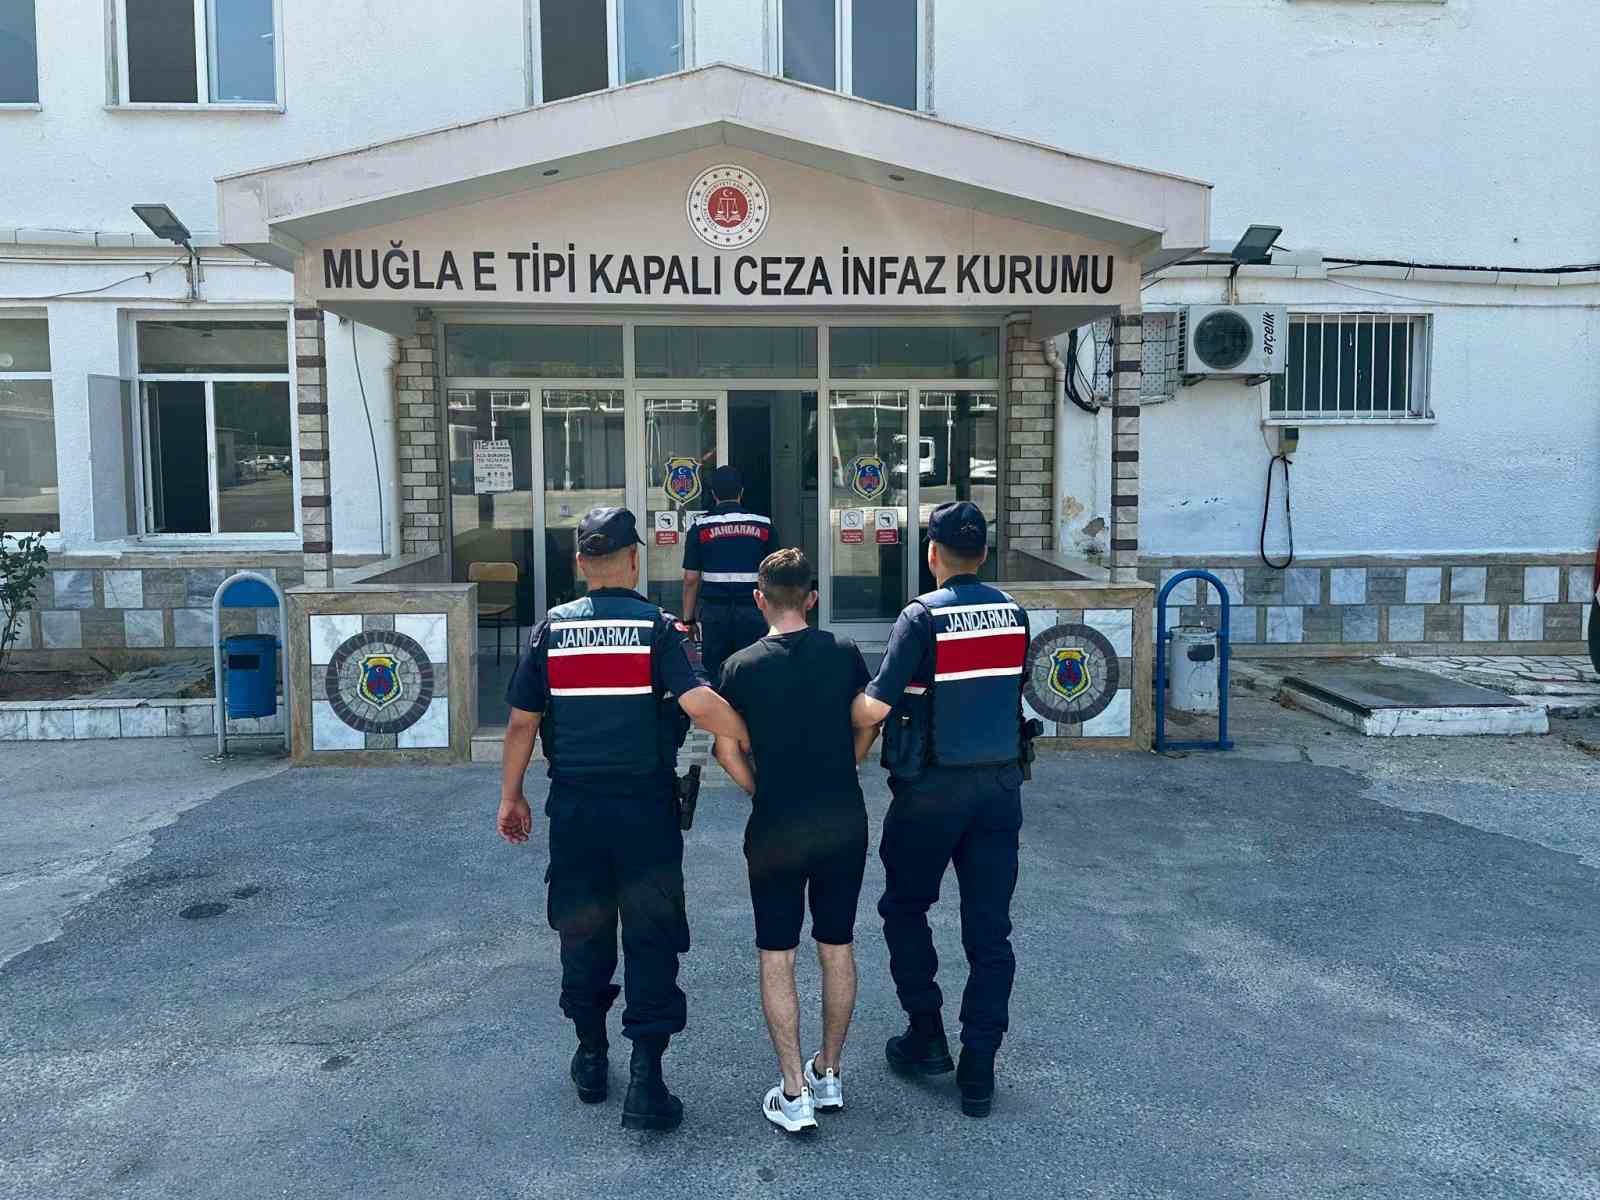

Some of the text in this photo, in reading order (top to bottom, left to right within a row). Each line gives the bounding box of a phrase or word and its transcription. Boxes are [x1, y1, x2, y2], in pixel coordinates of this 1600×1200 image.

[323, 240, 1114, 295] MUĞLA E TİPİ KAPALI CEZA İNFAZ KURUMU
[1262, 311, 1277, 355] arçelik
[708, 525, 761, 539] JANDARMA
[945, 608, 1018, 633] JANDARMA
[557, 627, 641, 648] JANDARMA
